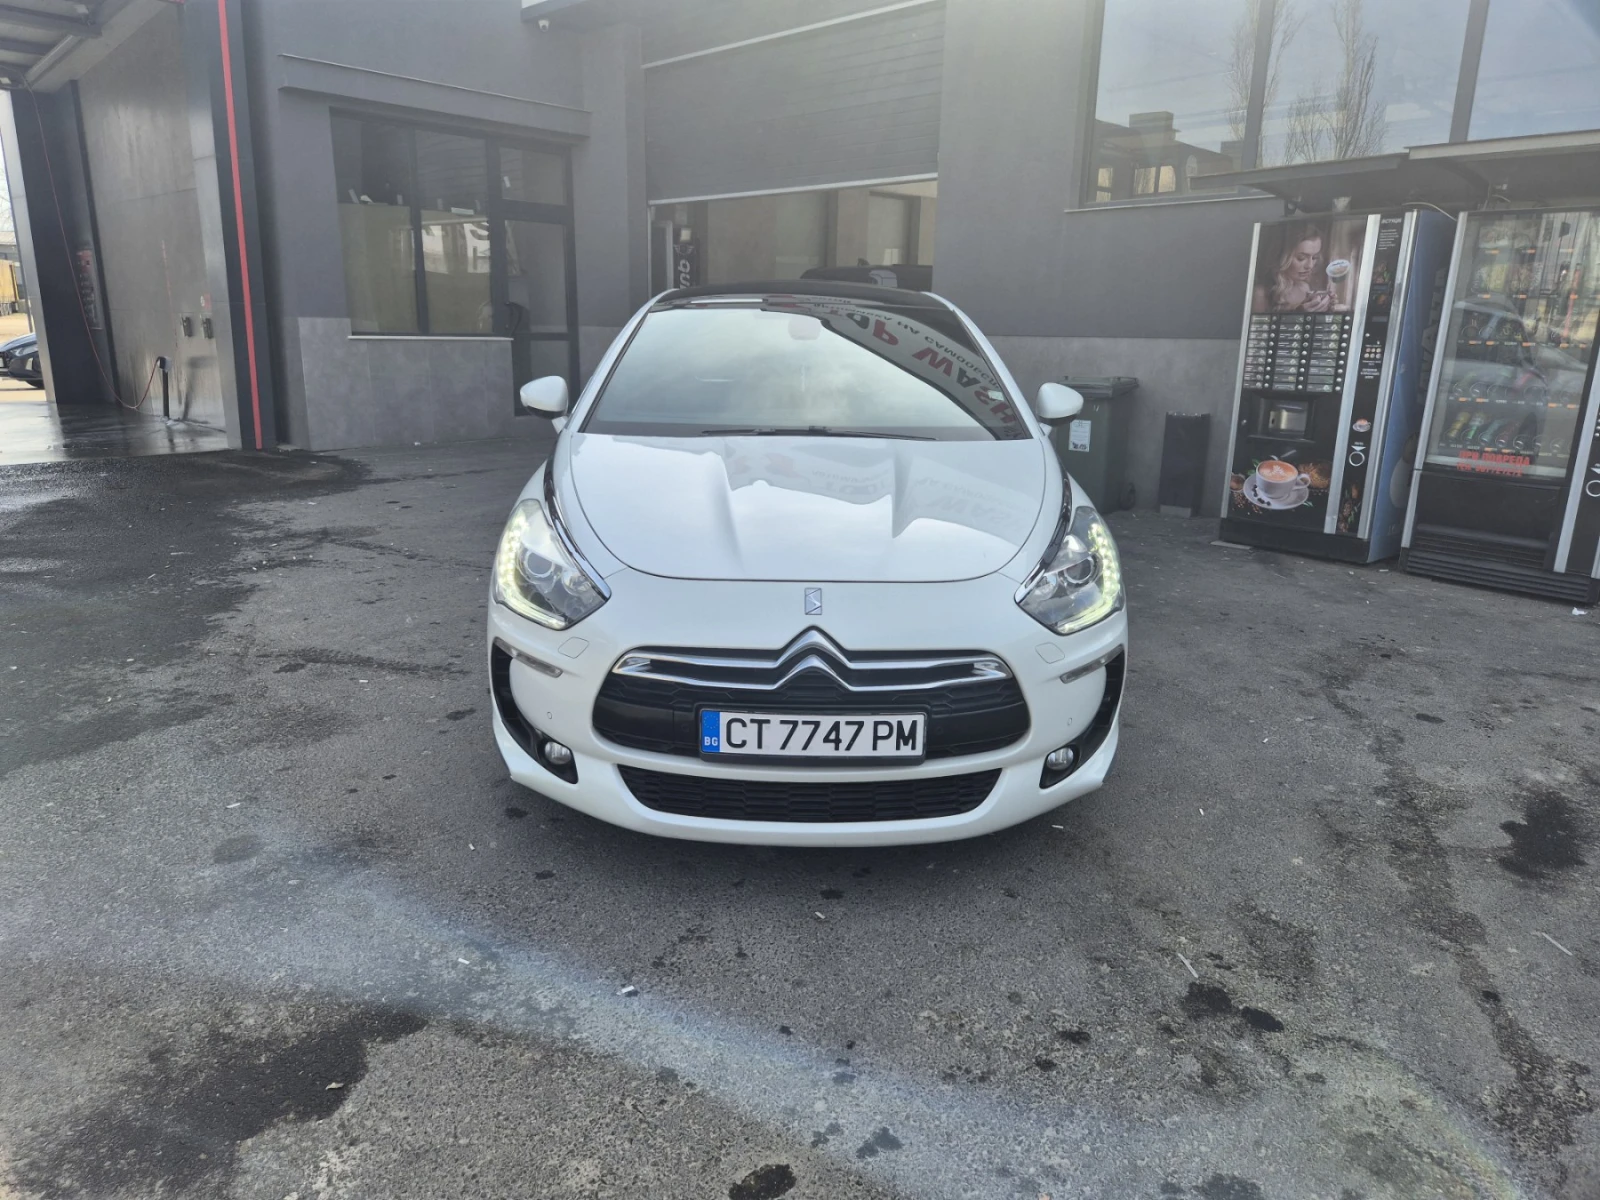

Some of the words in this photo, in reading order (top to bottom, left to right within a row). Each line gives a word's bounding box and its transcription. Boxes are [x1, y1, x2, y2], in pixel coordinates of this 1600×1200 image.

[704, 736, 719, 747] BG
[725, 717, 771, 750] CT
[779, 719, 865, 751] 7747
[872, 719, 918, 751] PM
